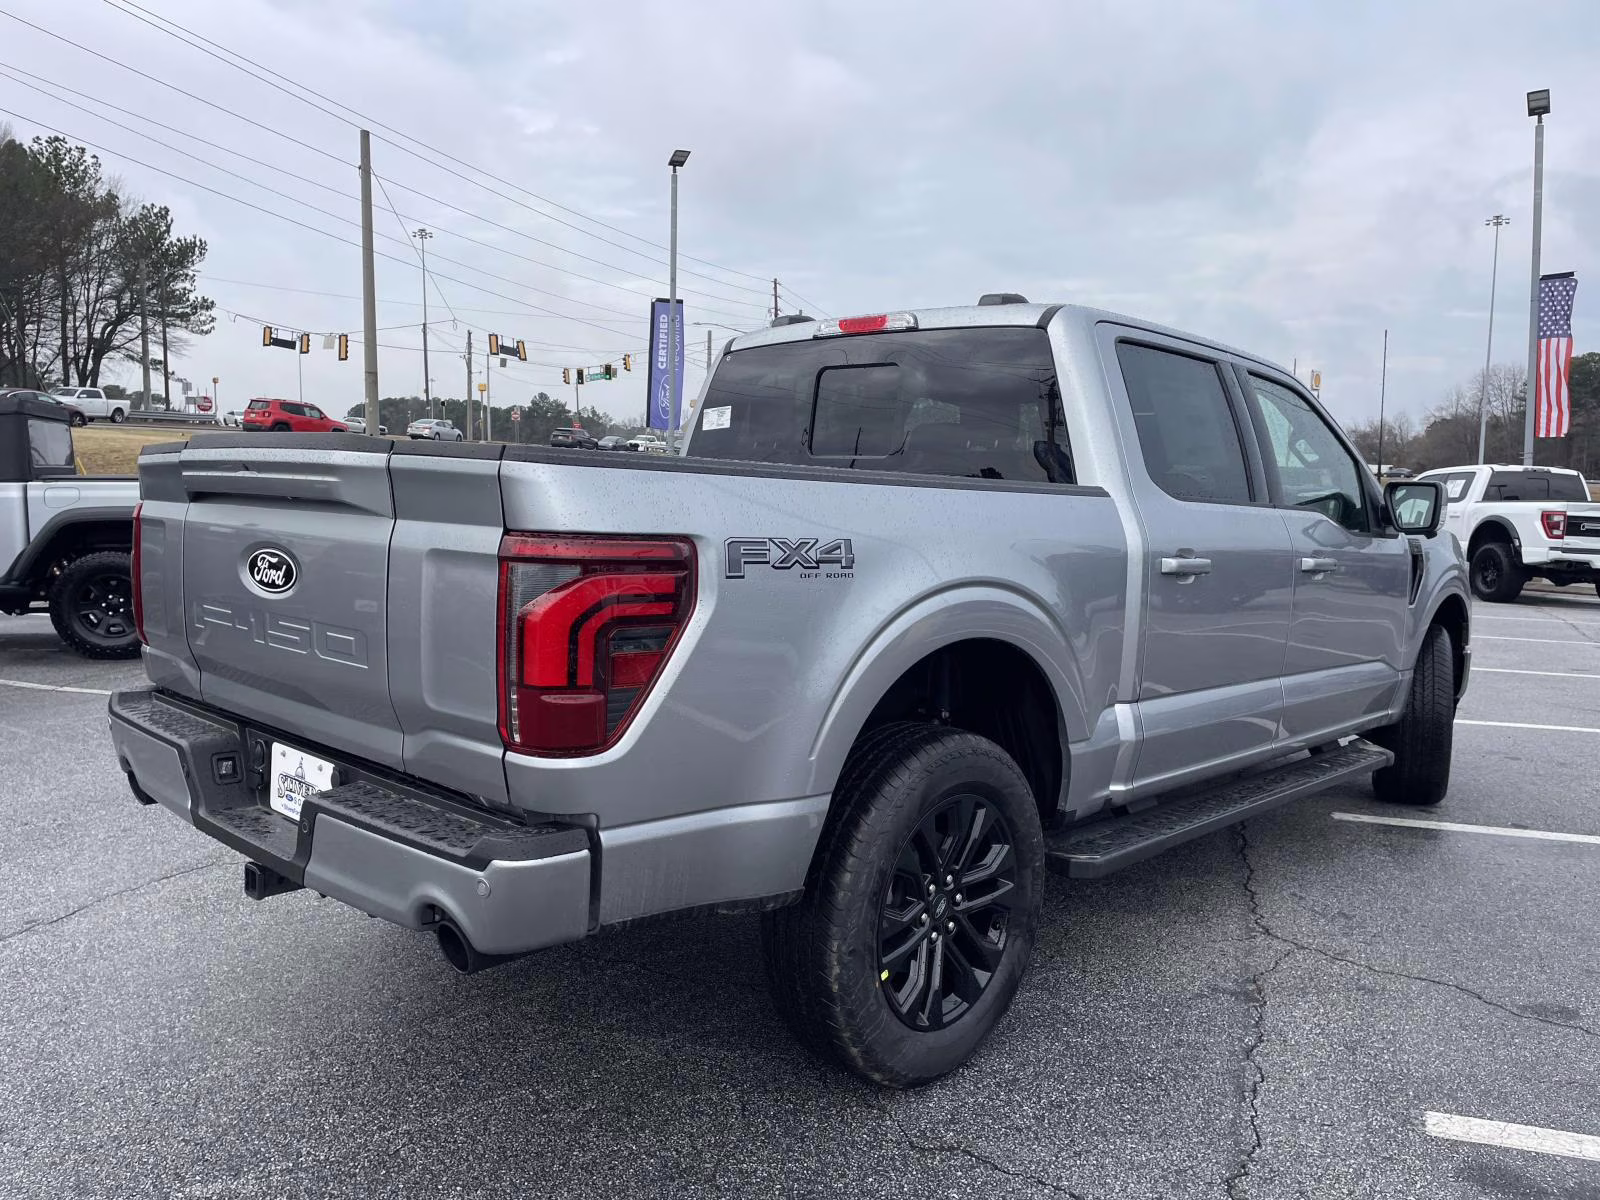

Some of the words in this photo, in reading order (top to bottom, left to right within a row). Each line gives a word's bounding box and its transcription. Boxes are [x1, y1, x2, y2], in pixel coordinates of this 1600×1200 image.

[658, 314, 668, 369] CERTIFIED
[254, 553, 286, 586] Ford
[724, 537, 855, 579] FX4
[193, 601, 369, 669] F-150
[277, 773, 322, 798] STIVER
